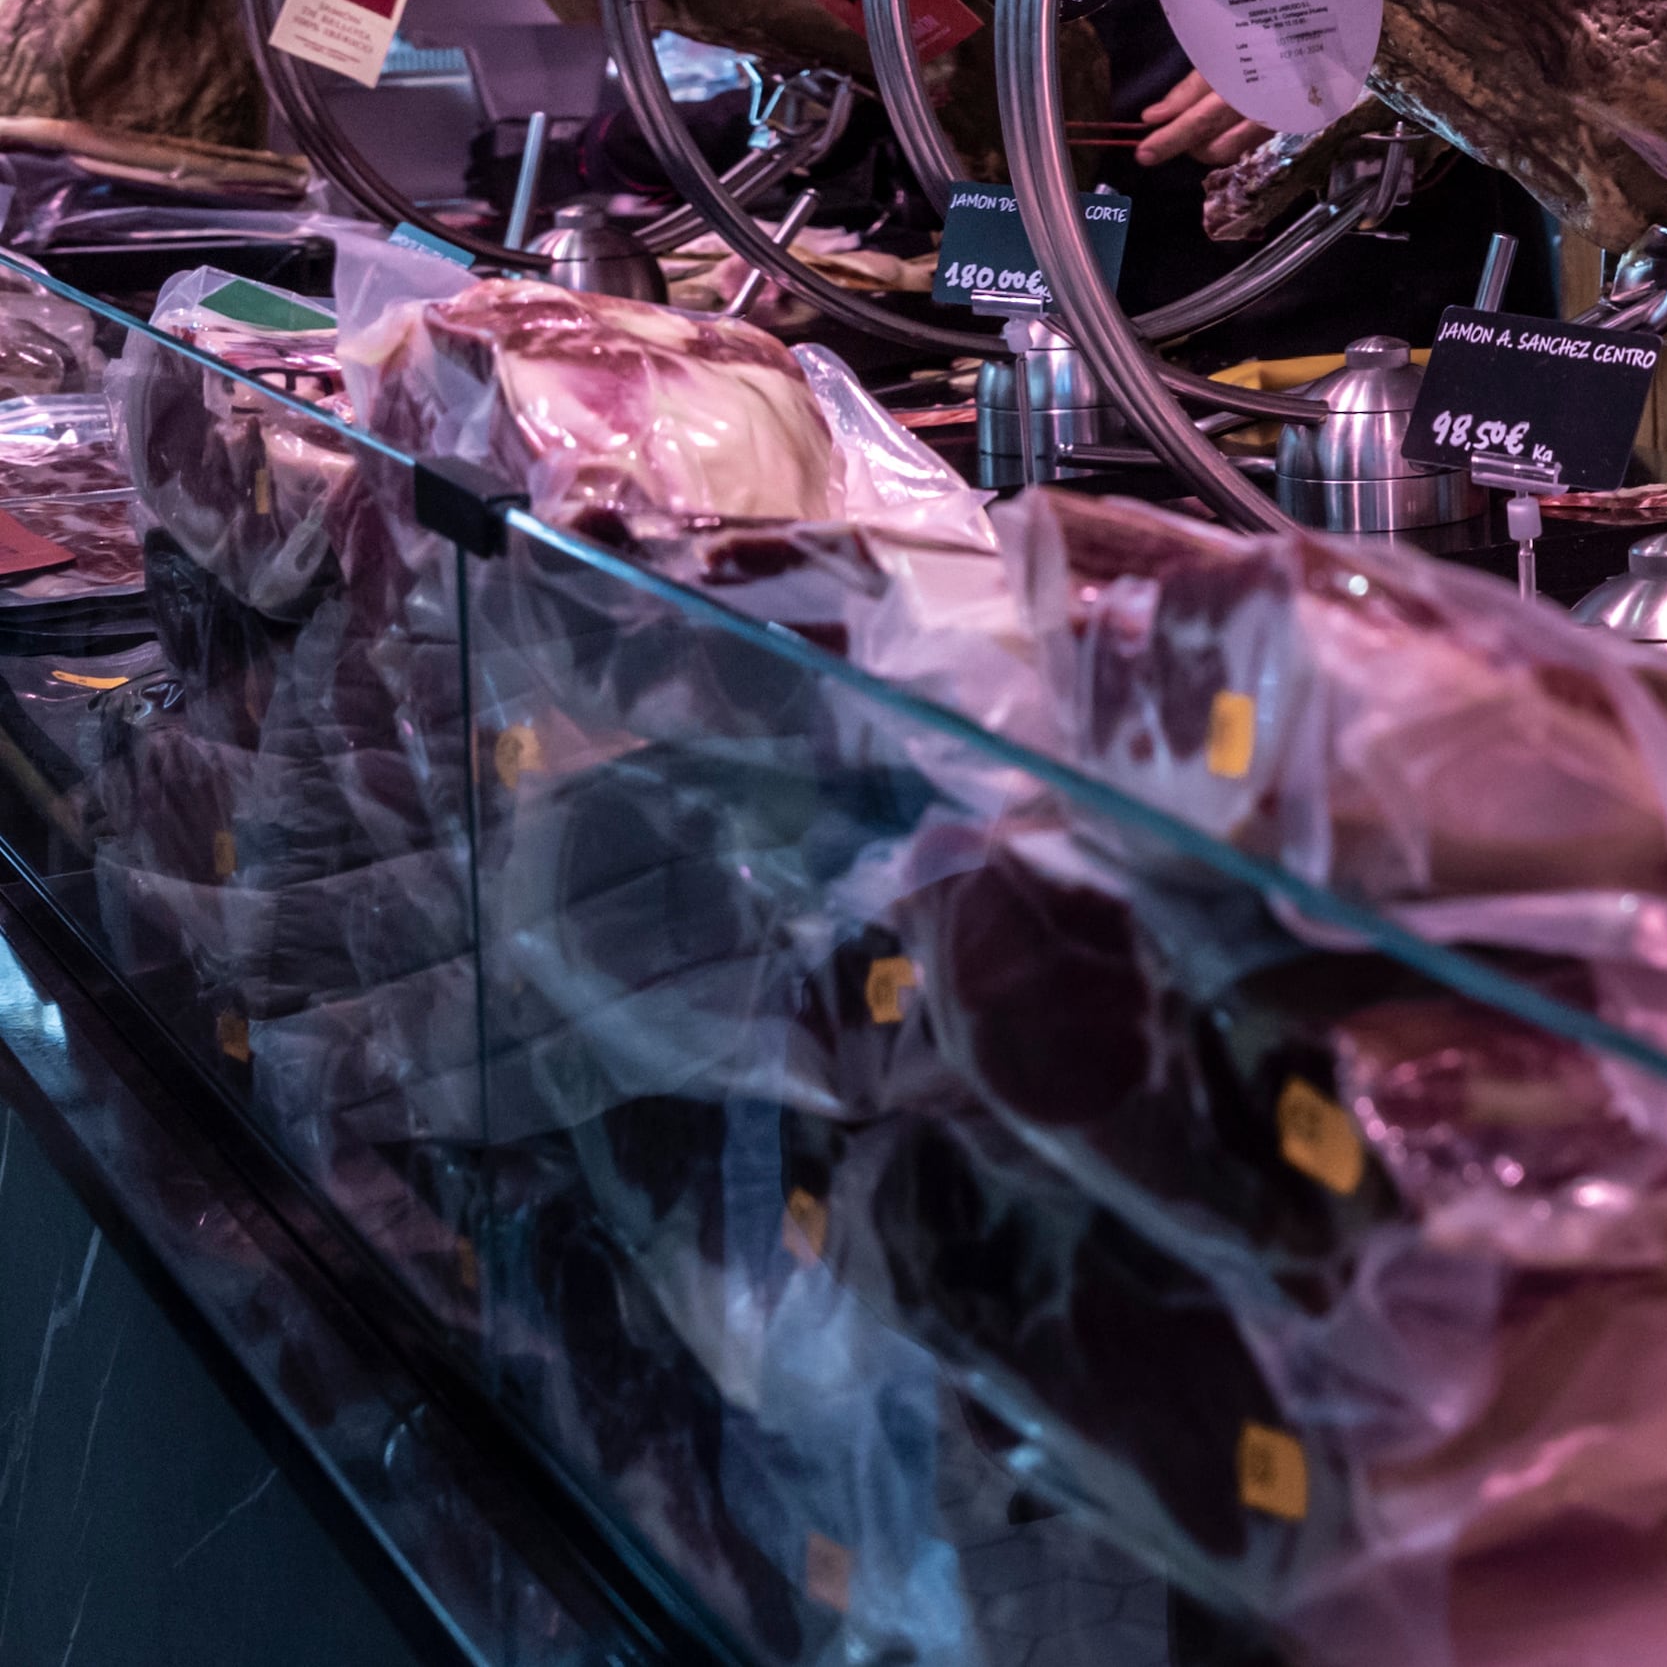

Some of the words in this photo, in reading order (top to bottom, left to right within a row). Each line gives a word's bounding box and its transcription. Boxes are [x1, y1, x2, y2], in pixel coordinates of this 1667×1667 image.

[950, 193, 997, 210] JAMON
[998, 196, 1017, 212] DE
[1085, 205, 1128, 223] CORTE
[1439, 322, 1494, 343] JAMON
[1496, 329, 1513, 348] A.
[1517, 333, 1590, 359] SANCHEZ
[1592, 344, 1657, 369] CENTRO
[1432, 410, 1530, 455] 98,50€
